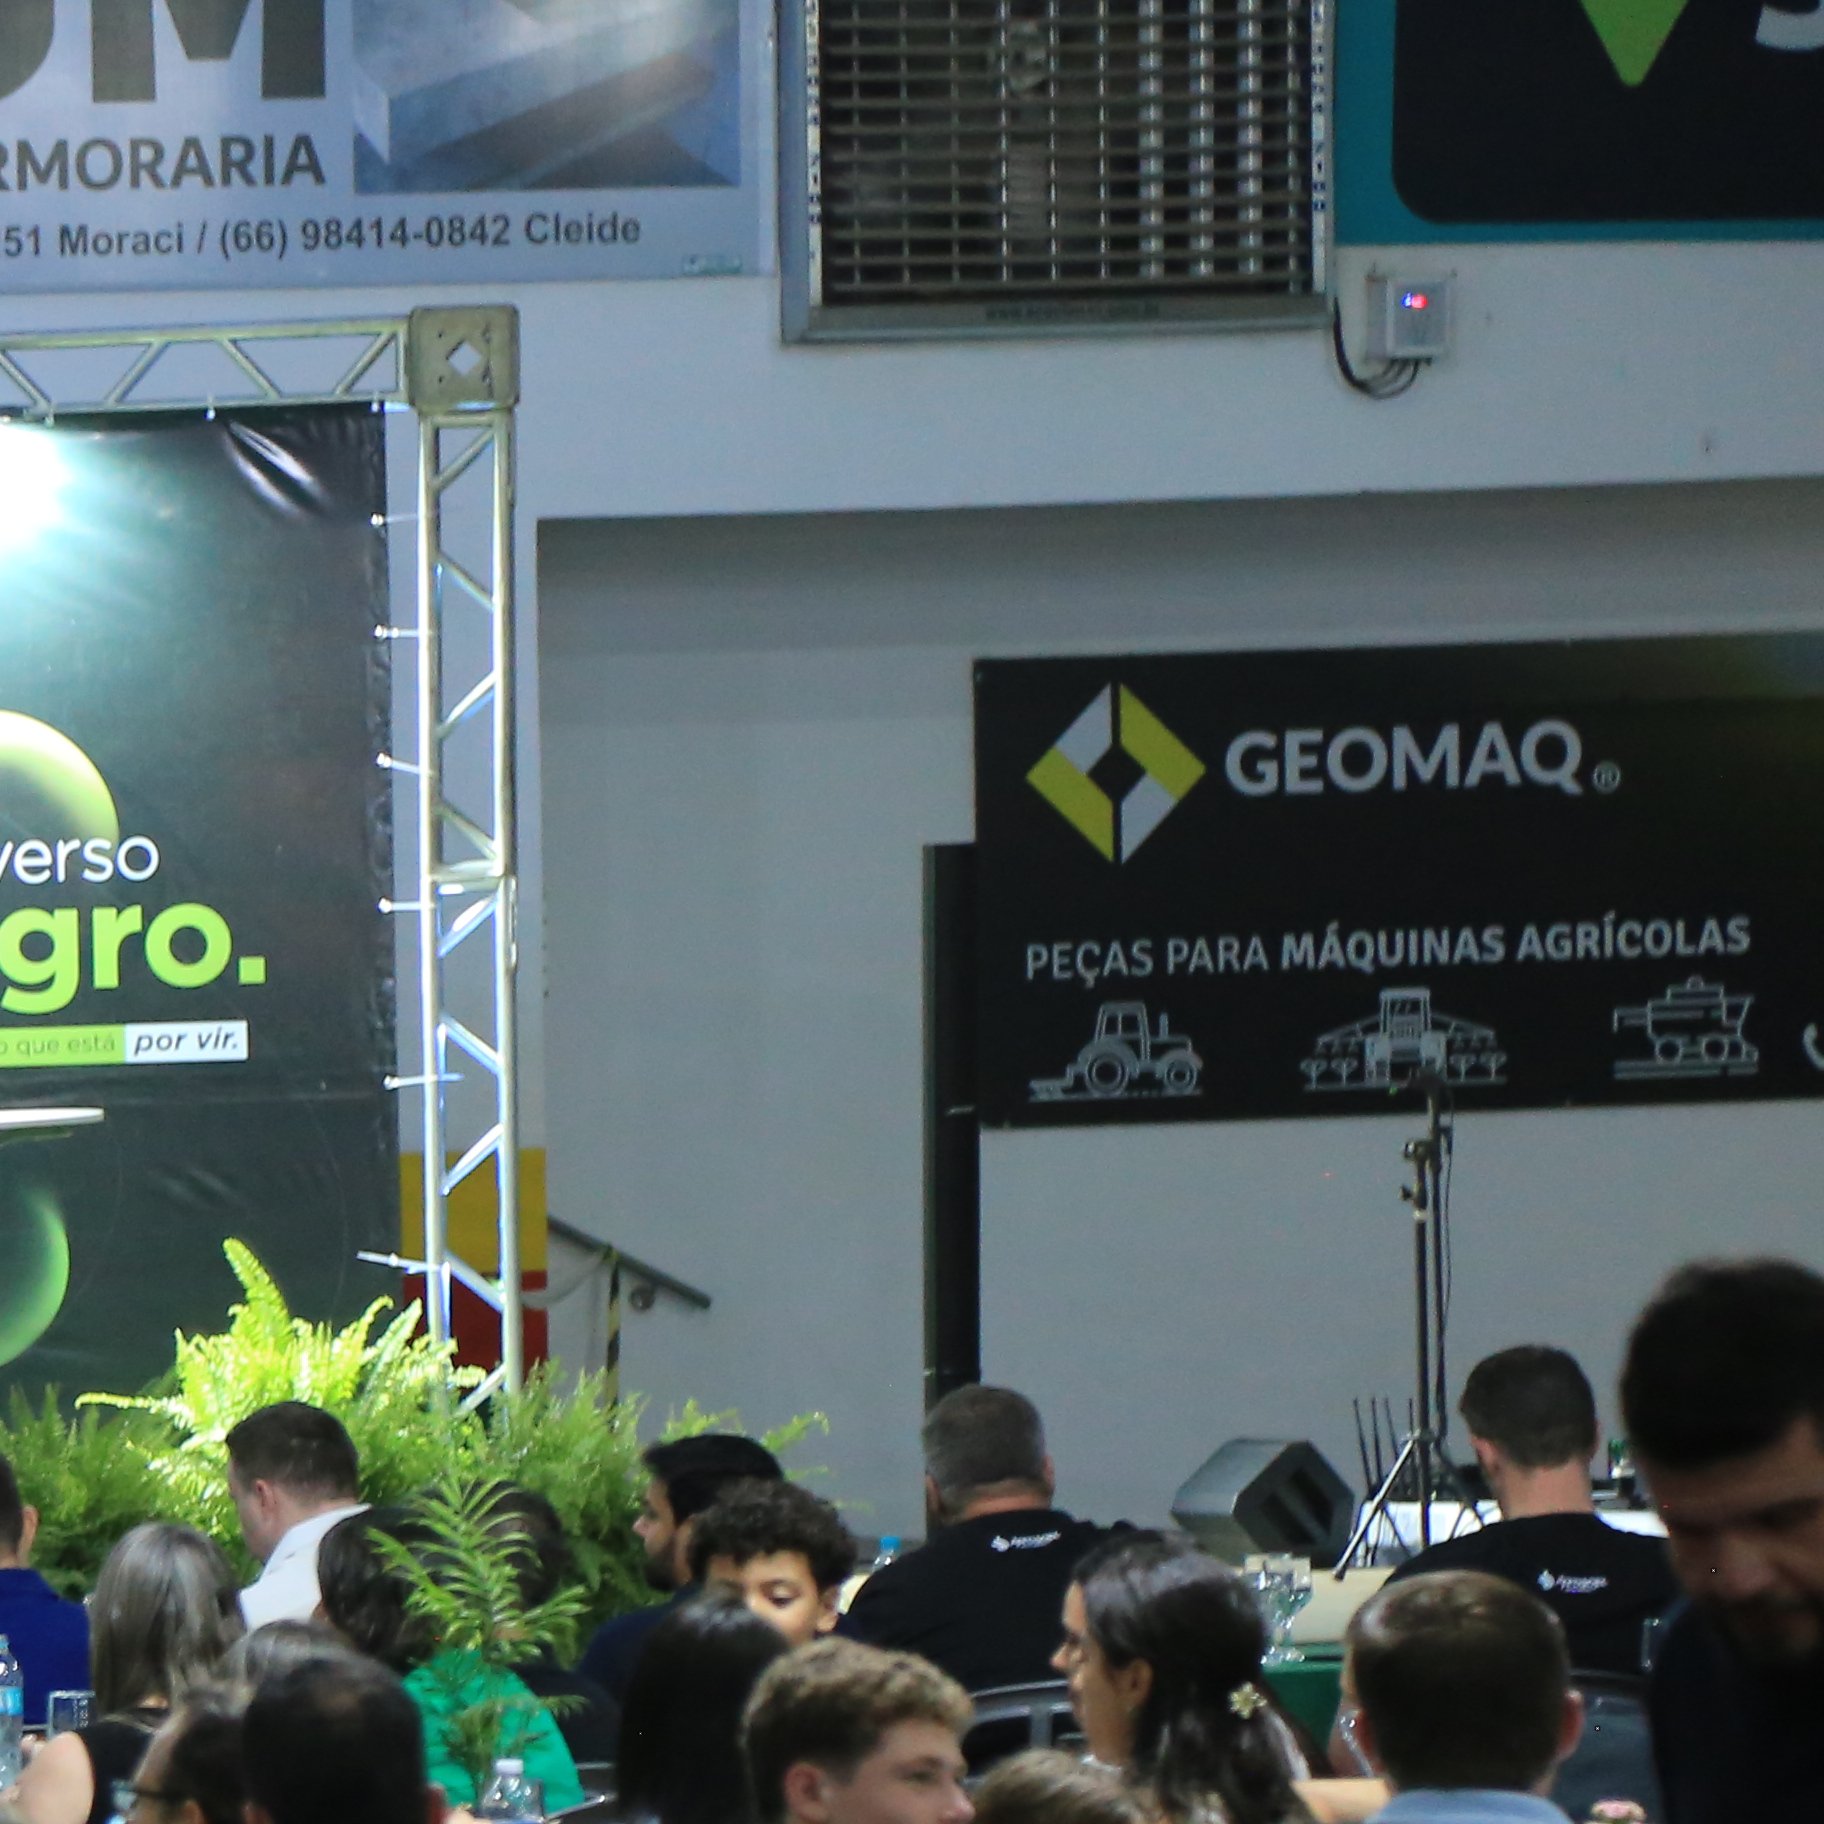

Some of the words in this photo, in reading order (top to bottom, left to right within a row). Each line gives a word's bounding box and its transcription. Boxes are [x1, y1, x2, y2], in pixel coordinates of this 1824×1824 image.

[58, 221, 186, 258] Moraci
[194, 221, 209, 255] /
[218, 218, 288, 261] (66)
[300, 212, 511, 252] 98414-0842
[523, 209, 642, 247] Cleide
[1026, 939, 1154, 988] PEÇAS
[1166, 935, 1269, 974] PARA
[1281, 920, 1506, 973] MÁQUINAS
[1515, 911, 1752, 961] AGRÍCOLAS
[14, 1038, 60, 1059] que
[66, 1033, 117, 1056] está
[132, 1033, 186, 1058] por
[196, 1026, 240, 1051] vir.
